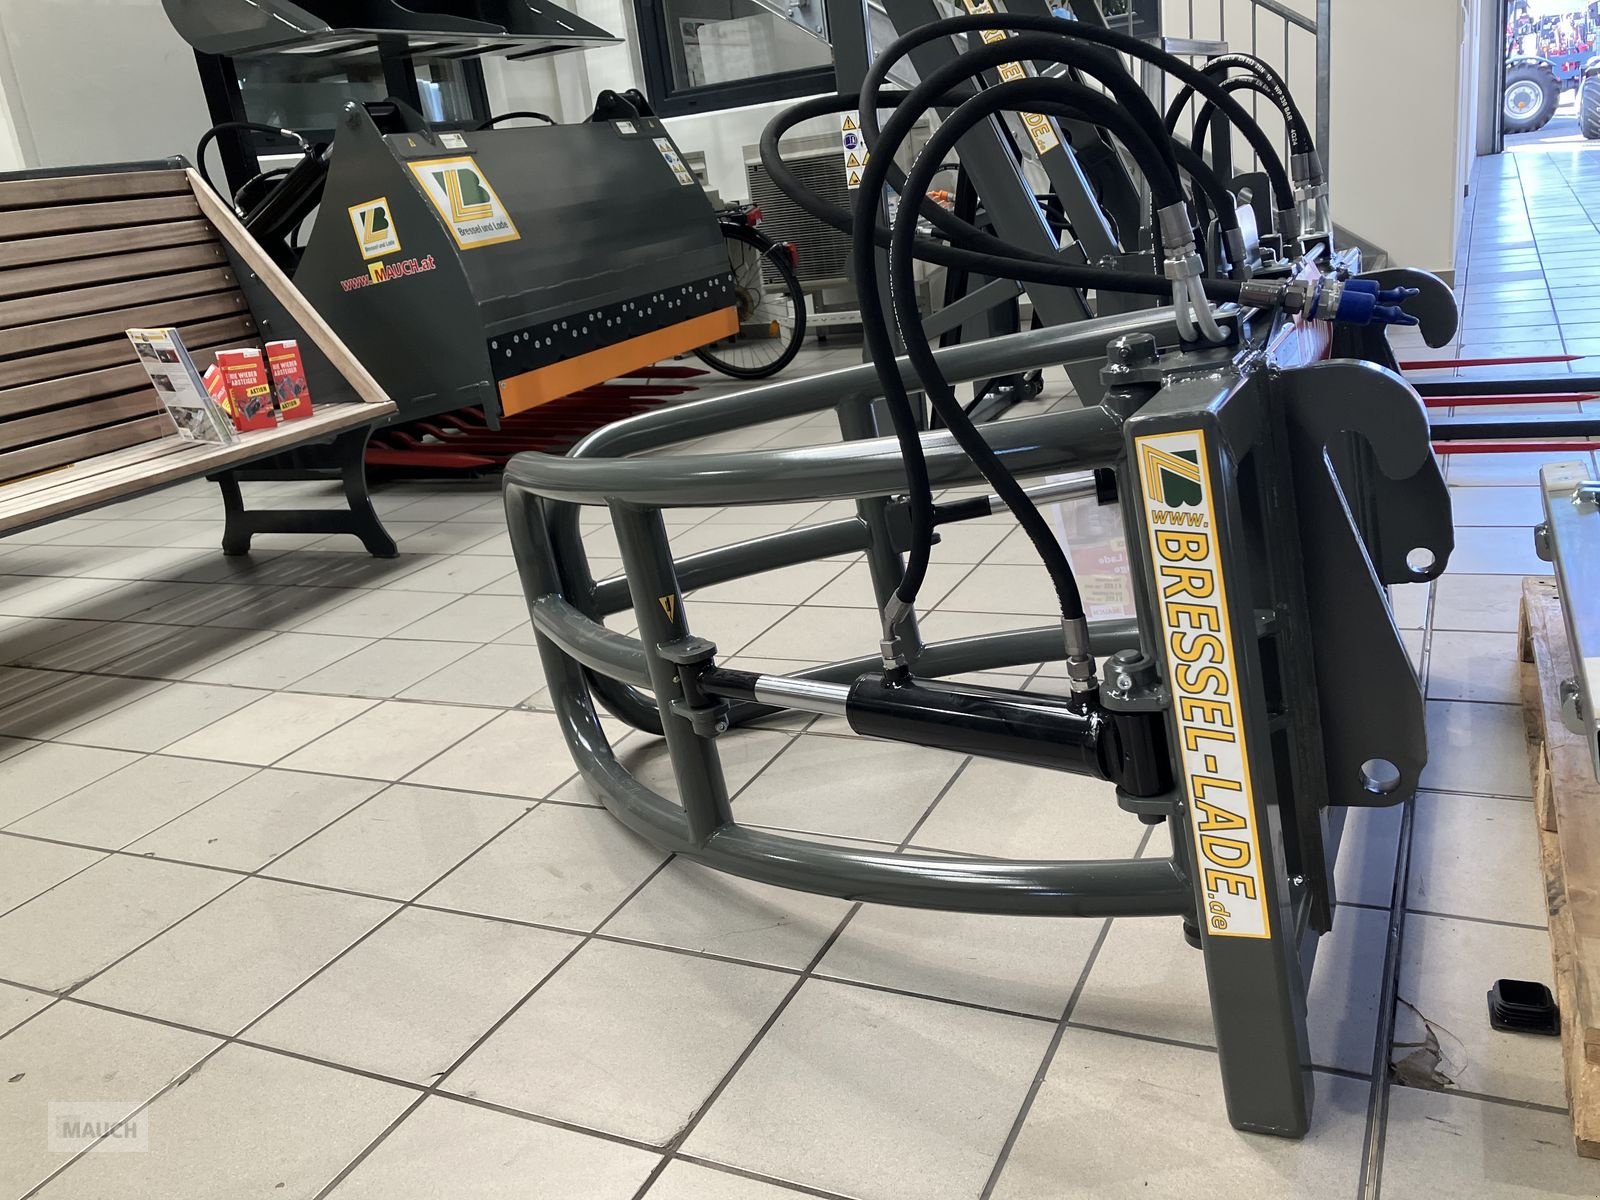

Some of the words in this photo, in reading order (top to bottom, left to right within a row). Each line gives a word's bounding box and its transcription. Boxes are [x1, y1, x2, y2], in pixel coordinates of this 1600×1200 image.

[1284, 106, 1293, 120] BAR
[458, 225, 482, 236] Bressel
[481, 222, 494, 233] und
[493, 220, 509, 231] Lade
[341, 255, 436, 292] www.MAUCH.at
[250, 386, 268, 395] AKTION
[282, 400, 298, 409] AKTION
[1152, 510, 1208, 528] www.
